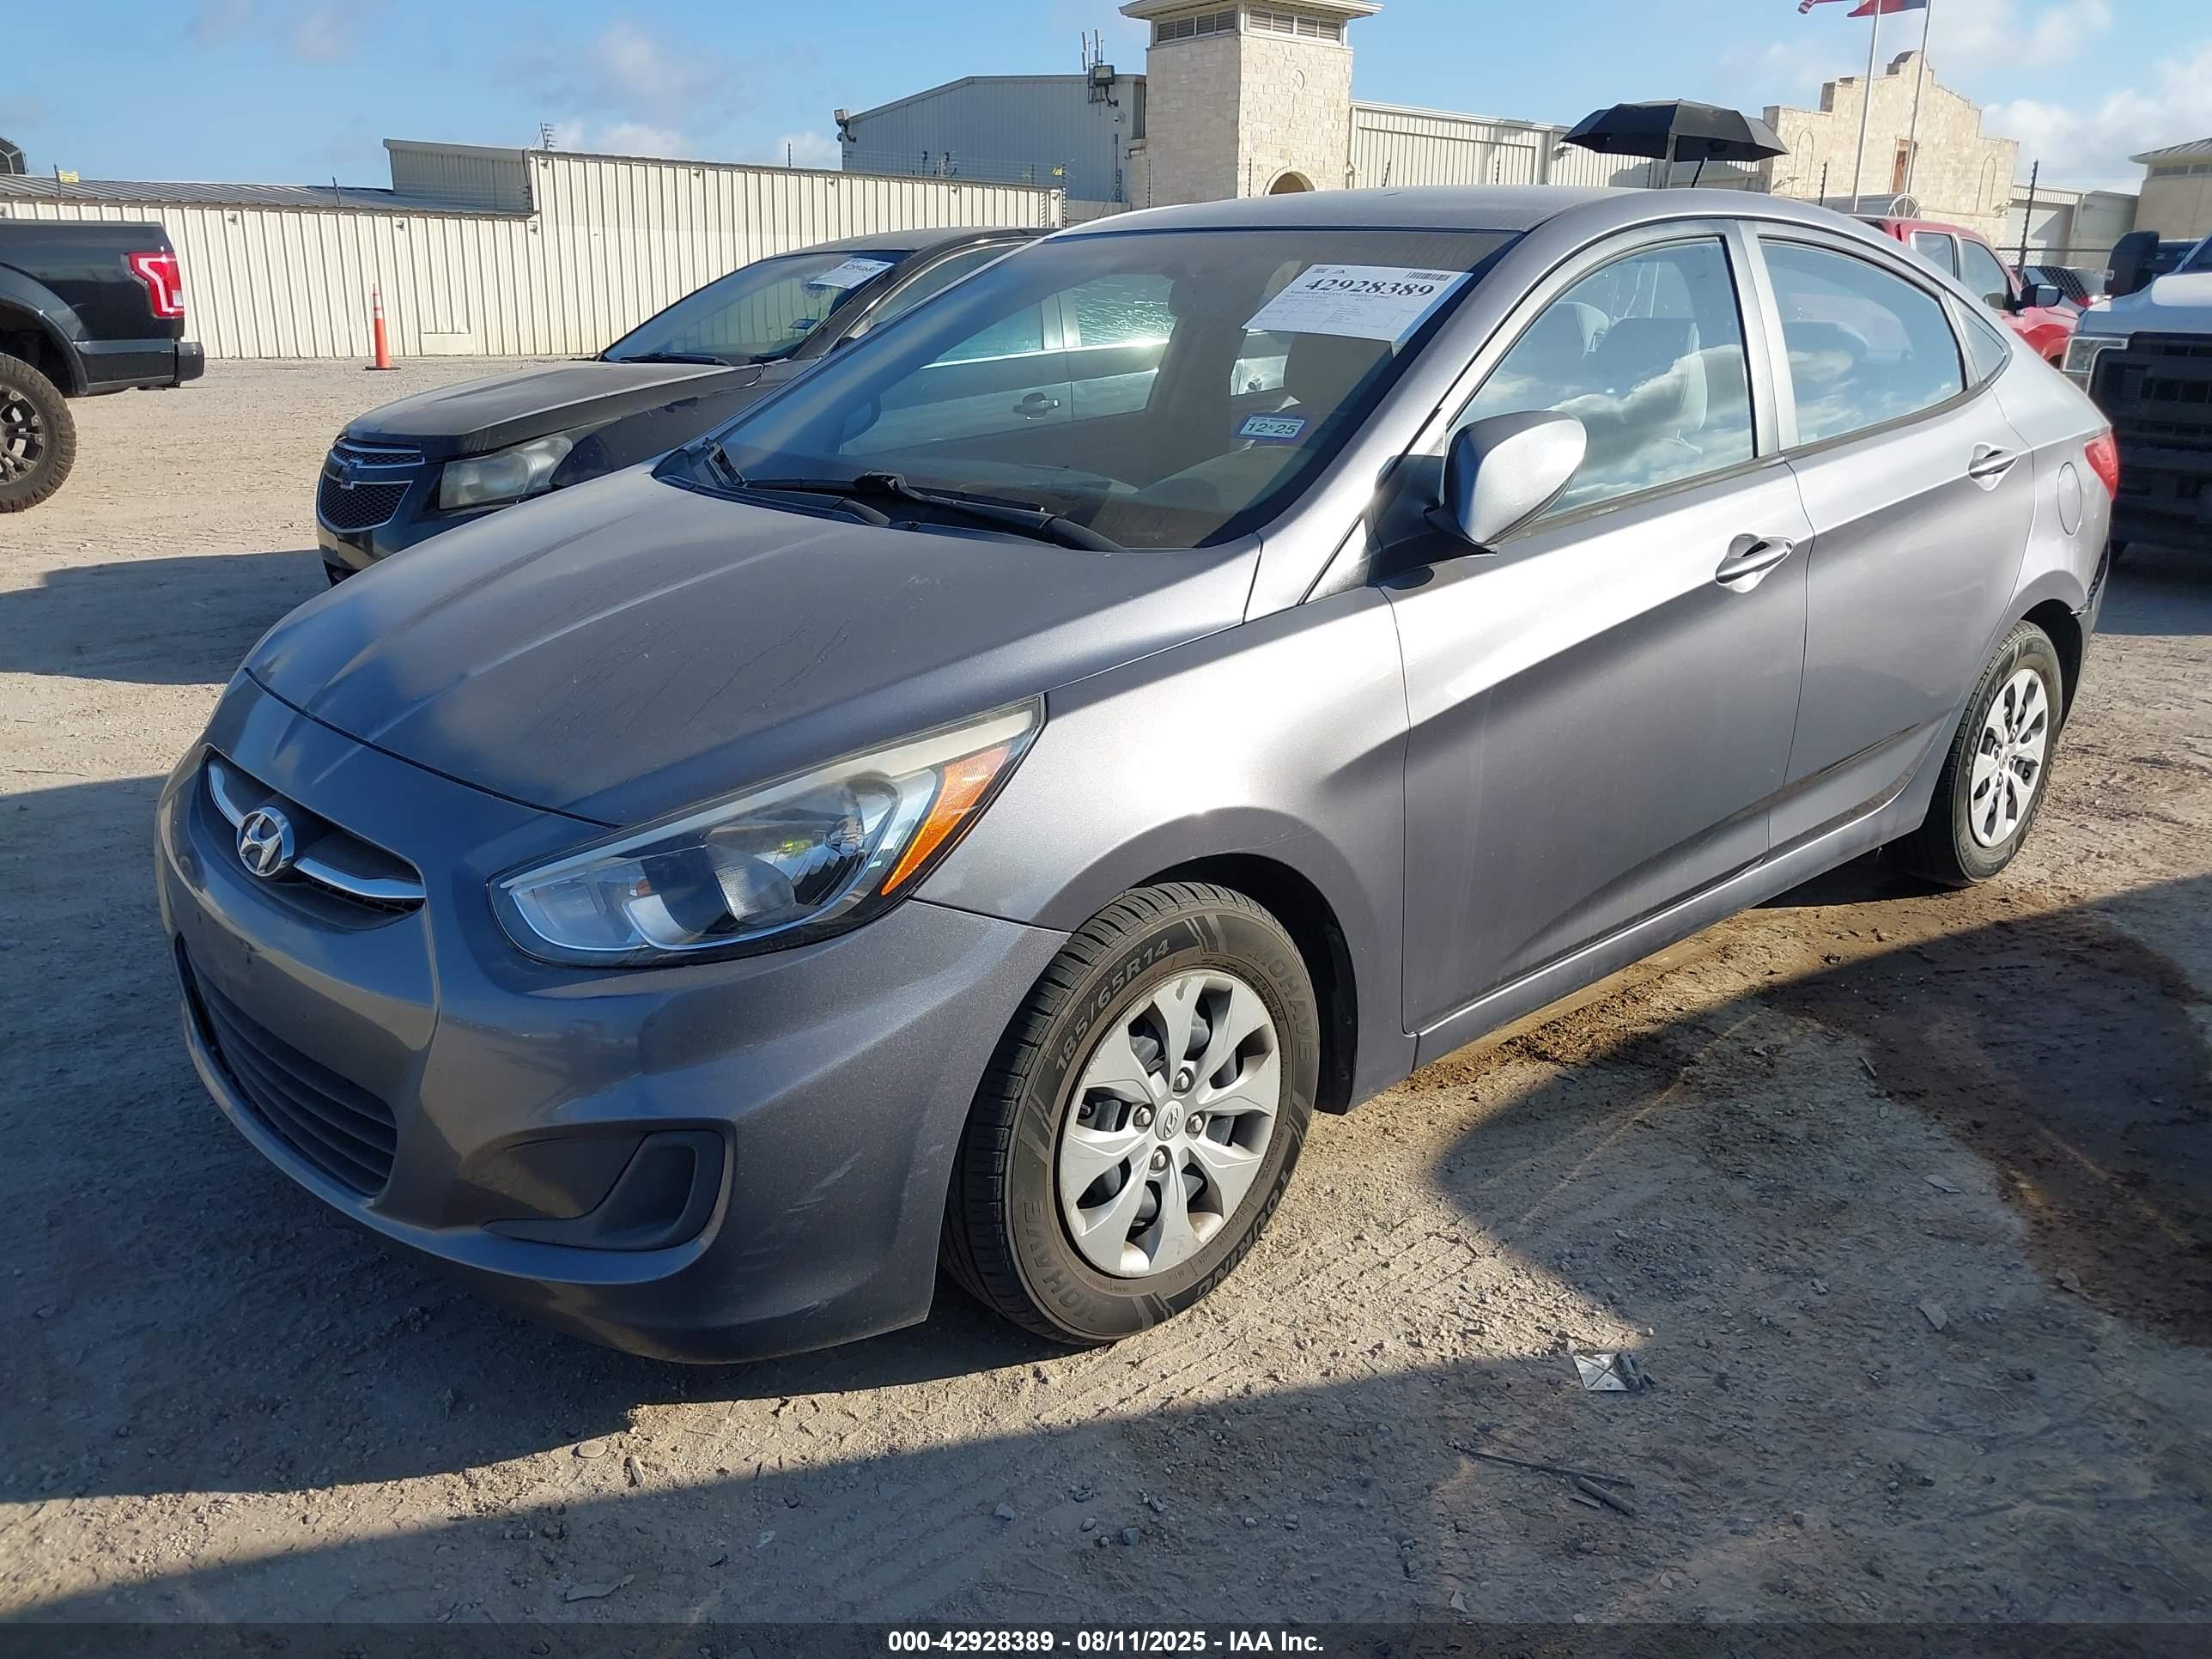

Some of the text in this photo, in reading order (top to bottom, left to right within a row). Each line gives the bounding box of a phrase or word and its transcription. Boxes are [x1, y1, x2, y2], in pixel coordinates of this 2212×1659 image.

[1304, 278, 1435, 297] 42928389
[1248, 422, 1297, 434] 12 25
[1247, 947, 1313, 1059] MOHAVE
[1024, 1201, 1111, 1322] MOHAVE
[1194, 1170, 1289, 1302] TOURING
